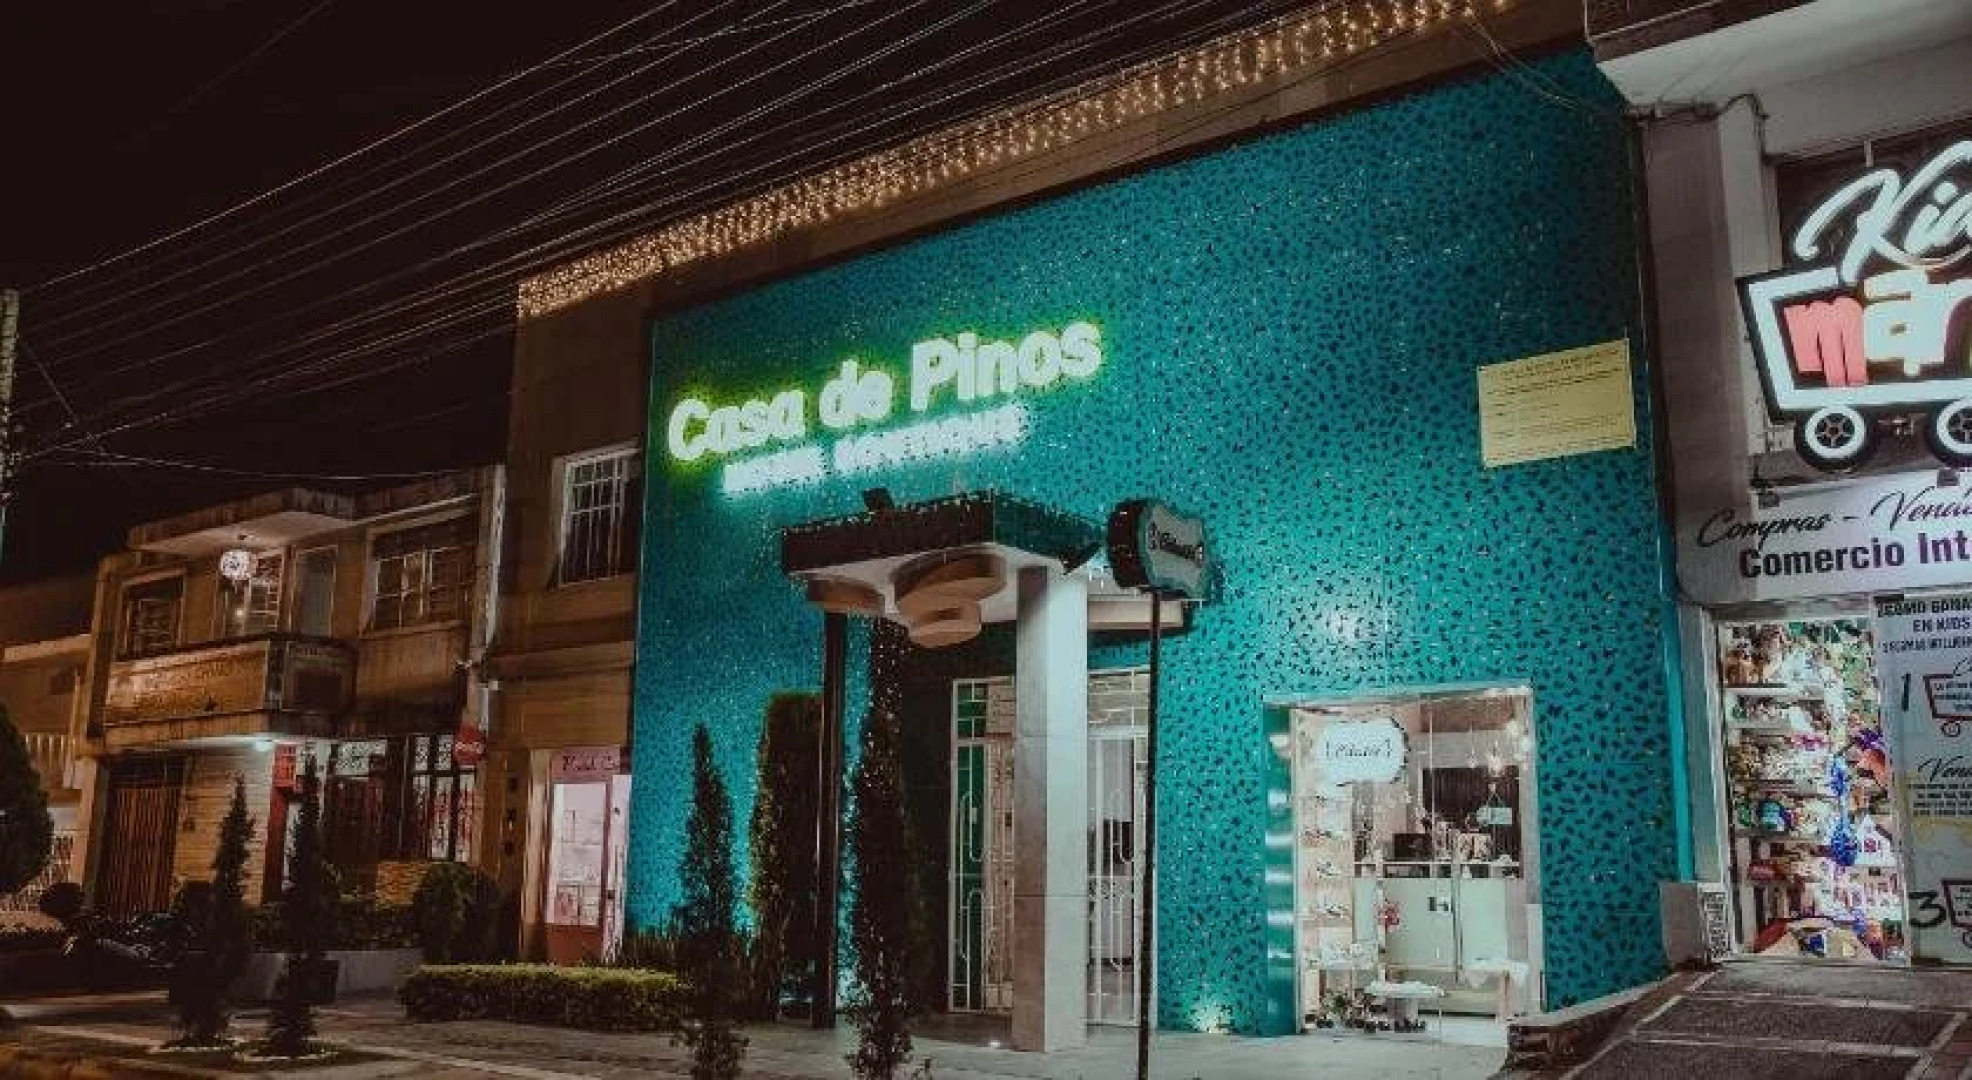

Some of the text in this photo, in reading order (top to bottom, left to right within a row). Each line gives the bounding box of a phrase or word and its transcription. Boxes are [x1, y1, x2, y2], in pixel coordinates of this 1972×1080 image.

[668, 321, 1102, 461] Casa de Pinos
[1697, 508, 1832, 551] Compras
[1739, 536, 1905, 580] Comercio
[1908, 890, 1947, 928] 3
